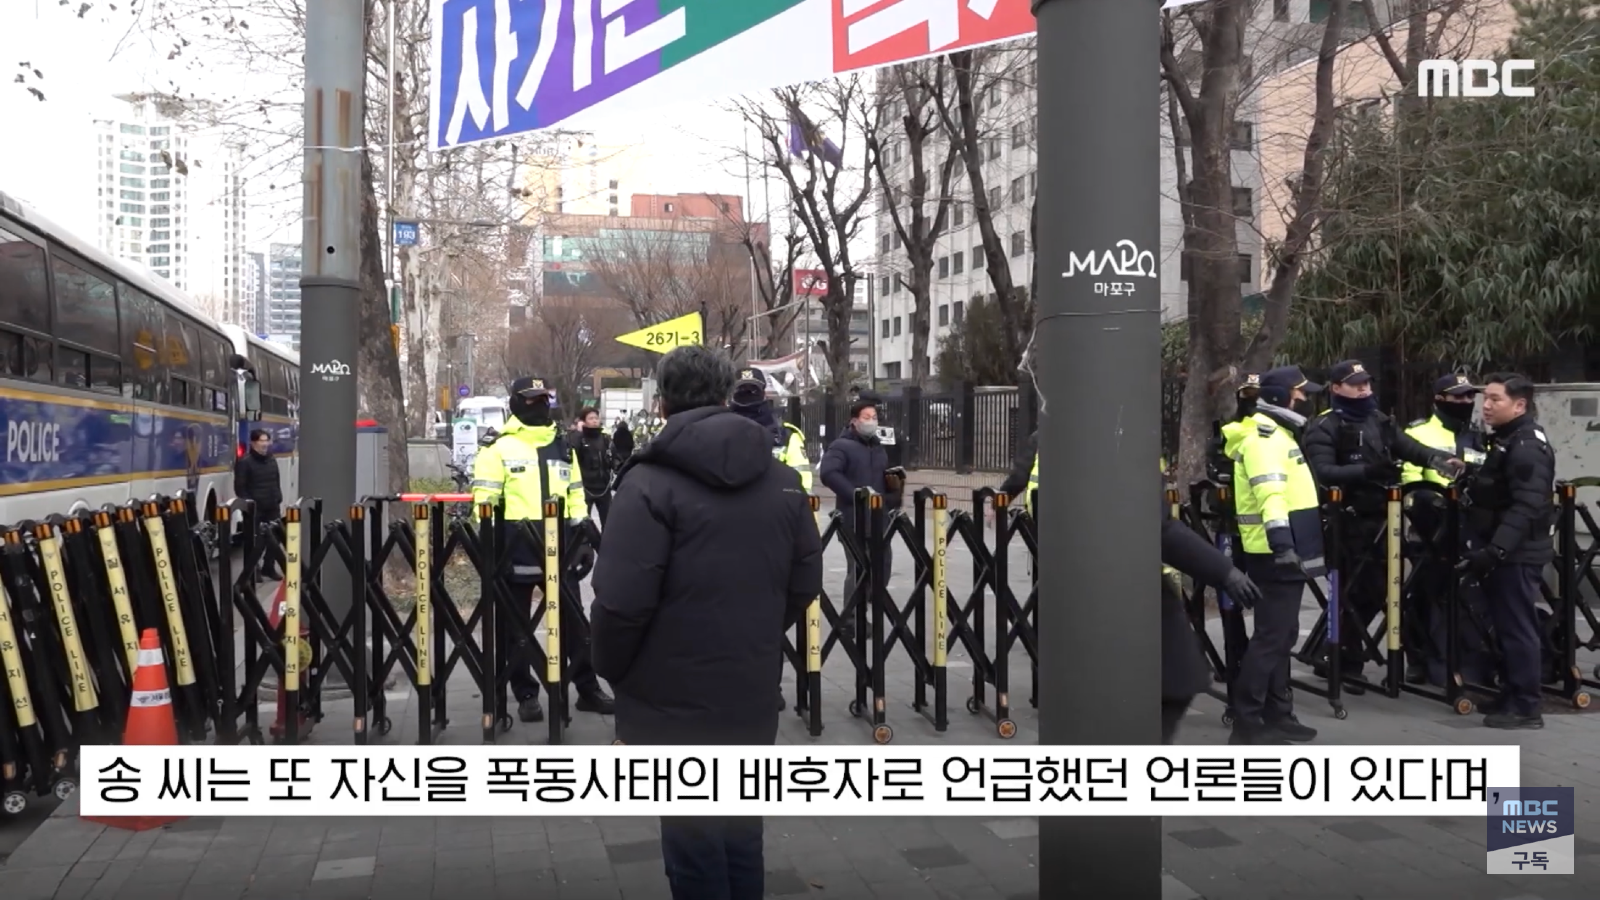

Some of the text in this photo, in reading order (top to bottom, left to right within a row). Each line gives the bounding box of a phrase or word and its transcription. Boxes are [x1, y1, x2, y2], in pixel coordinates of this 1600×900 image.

[646, 330, 700, 346] 26기-3
[1094, 282, 1136, 297] 마포구
[7, 420, 60, 462] POLICE
[50, 570, 87, 693] POLICE LINE
[156, 548, 188, 668] POLICE LINE
[418, 549, 428, 669] POLICE LINE
[937, 537, 946, 651] POLICE LINE
